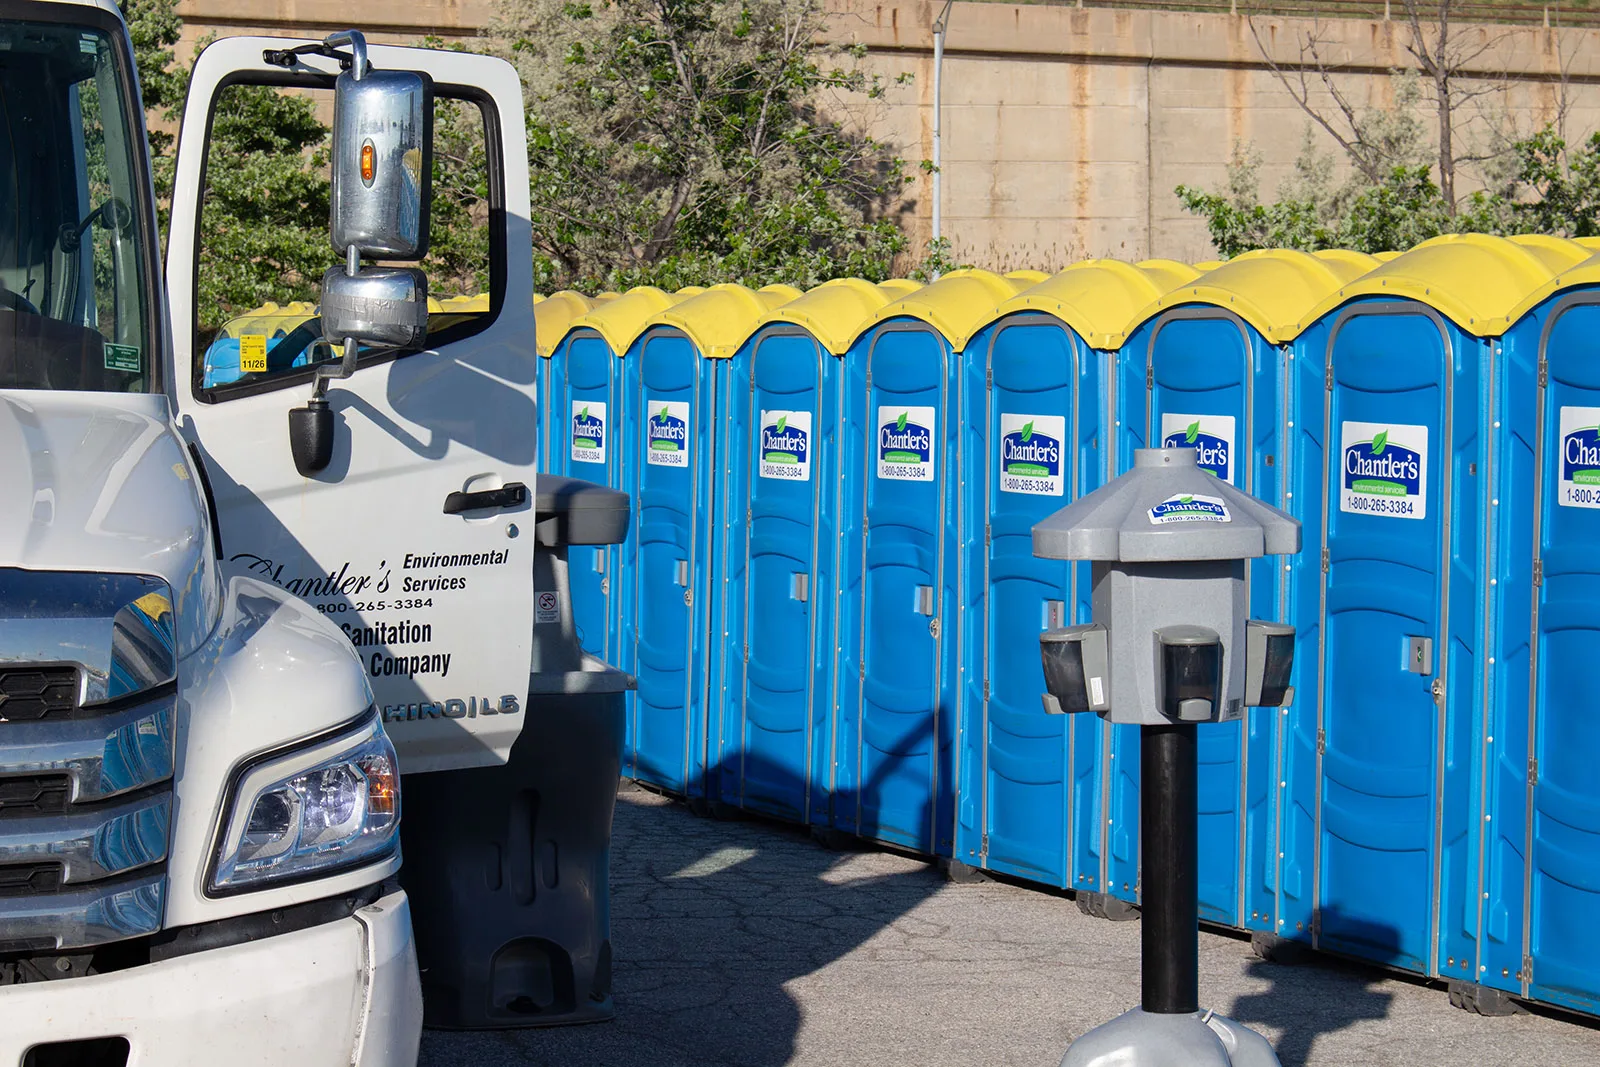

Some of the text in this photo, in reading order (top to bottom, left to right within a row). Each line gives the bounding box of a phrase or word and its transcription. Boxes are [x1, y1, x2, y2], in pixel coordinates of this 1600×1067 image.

[242, 359, 265, 369] 11/26
[573, 418, 602, 438] Chantler's
[649, 419, 684, 440] Chantler's
[763, 429, 806, 452] Chantler's
[881, 428, 929, 451] Chantler's
[1003, 437, 1058, 463] Chantler's
[1565, 437, 1600, 466] Cha
[763, 465, 802, 477] 1-800-265-3384
[881, 465, 926, 478] 1-800-265-3384
[1346, 449, 1418, 480] Chantler's
[1004, 478, 1054, 492] 1-800-265-3384
[1347, 496, 1414, 514] 1-800-265-3384
[1567, 487, 1600, 504] 1-800-2
[1153, 502, 1222, 513] Chantler's
[402, 549, 510, 570] Environmental
[402, 575, 467, 593] Services
[316, 598, 434, 614] 800-265-3384
[341, 620, 432, 647] Sanitation
[370, 652, 451, 680] Company
